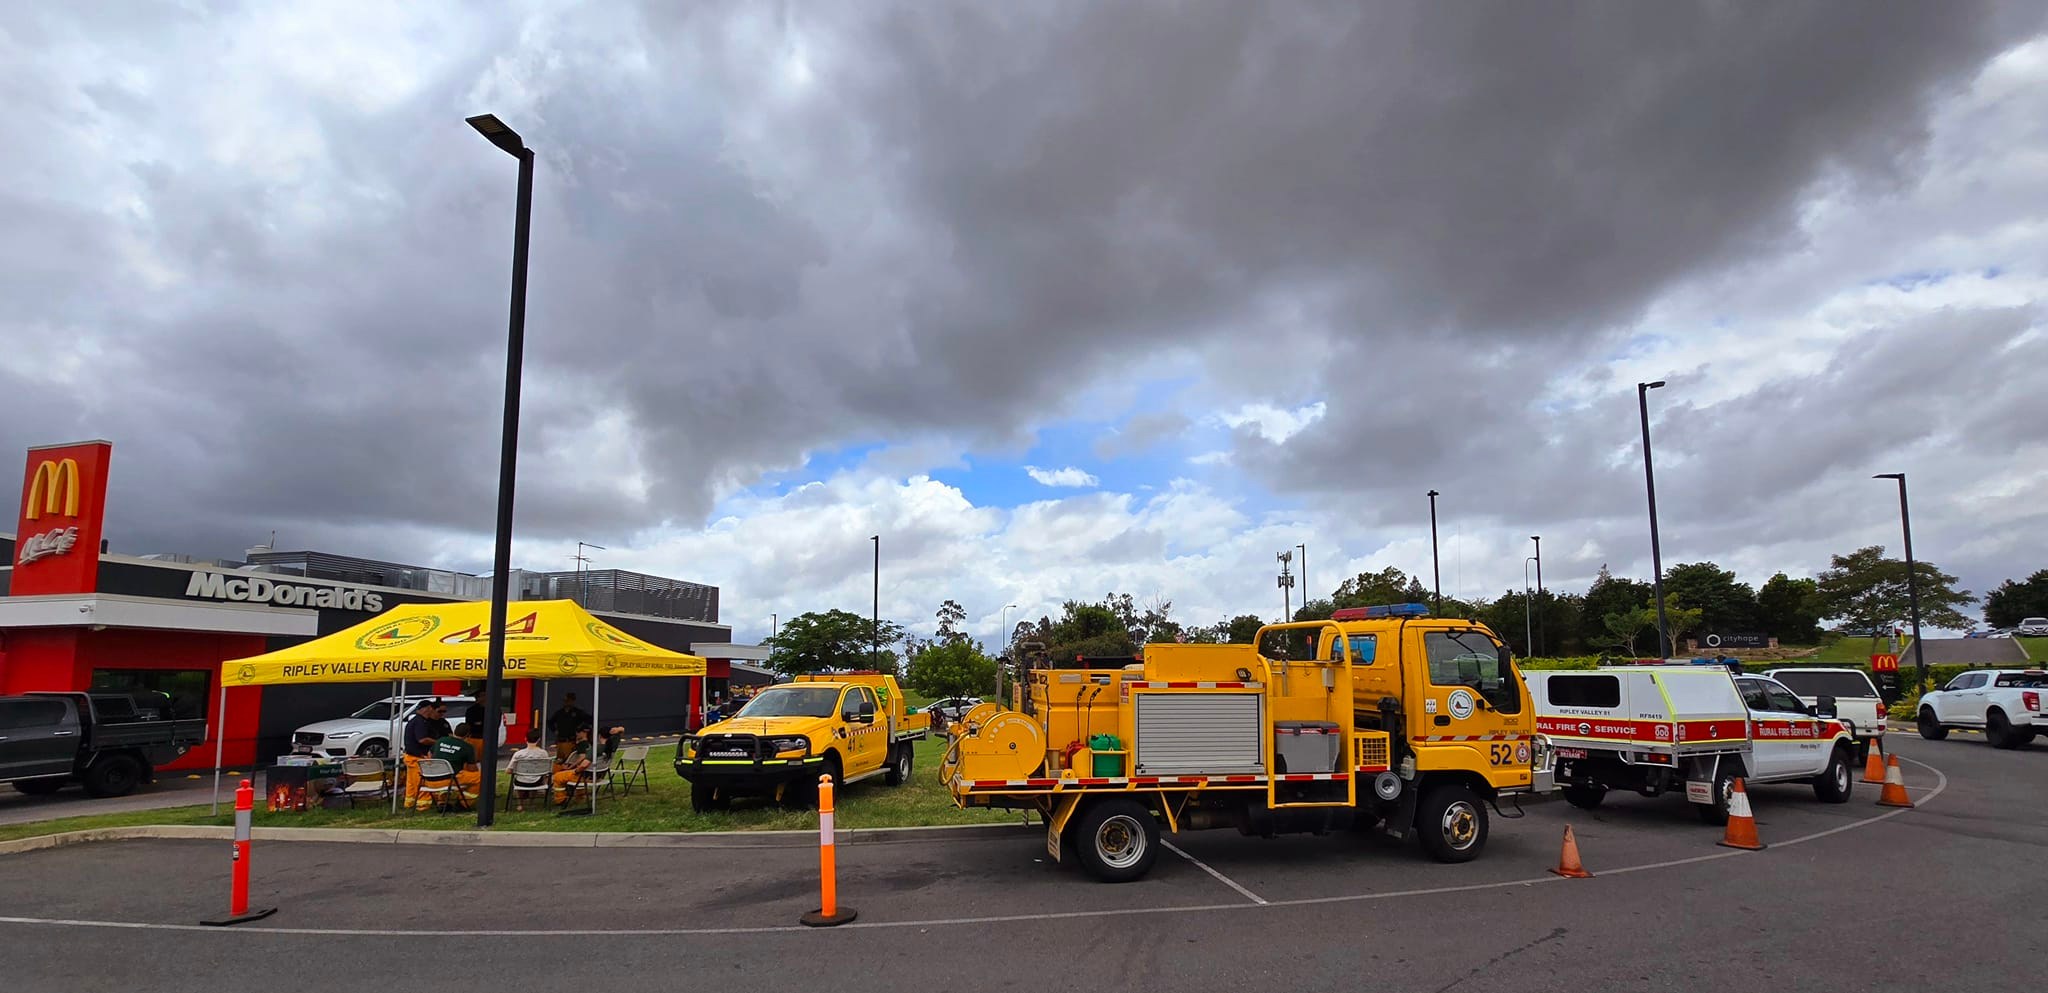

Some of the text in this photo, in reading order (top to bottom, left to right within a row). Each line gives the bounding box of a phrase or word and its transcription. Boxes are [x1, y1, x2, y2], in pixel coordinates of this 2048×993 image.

[185, 571, 383, 613] McDonald's
[1722, 634, 1759, 642] cityhope
[283, 658, 526, 677] RIPLEY VALLEY RURAL FIRE BRIDE
[1536, 722, 1637, 735] RAL FIRE SERVICE
[1759, 727, 1811, 737] RURAL FIRE SERVICE
[847, 736, 856, 753] 41
[1490, 743, 1512, 766] 52
